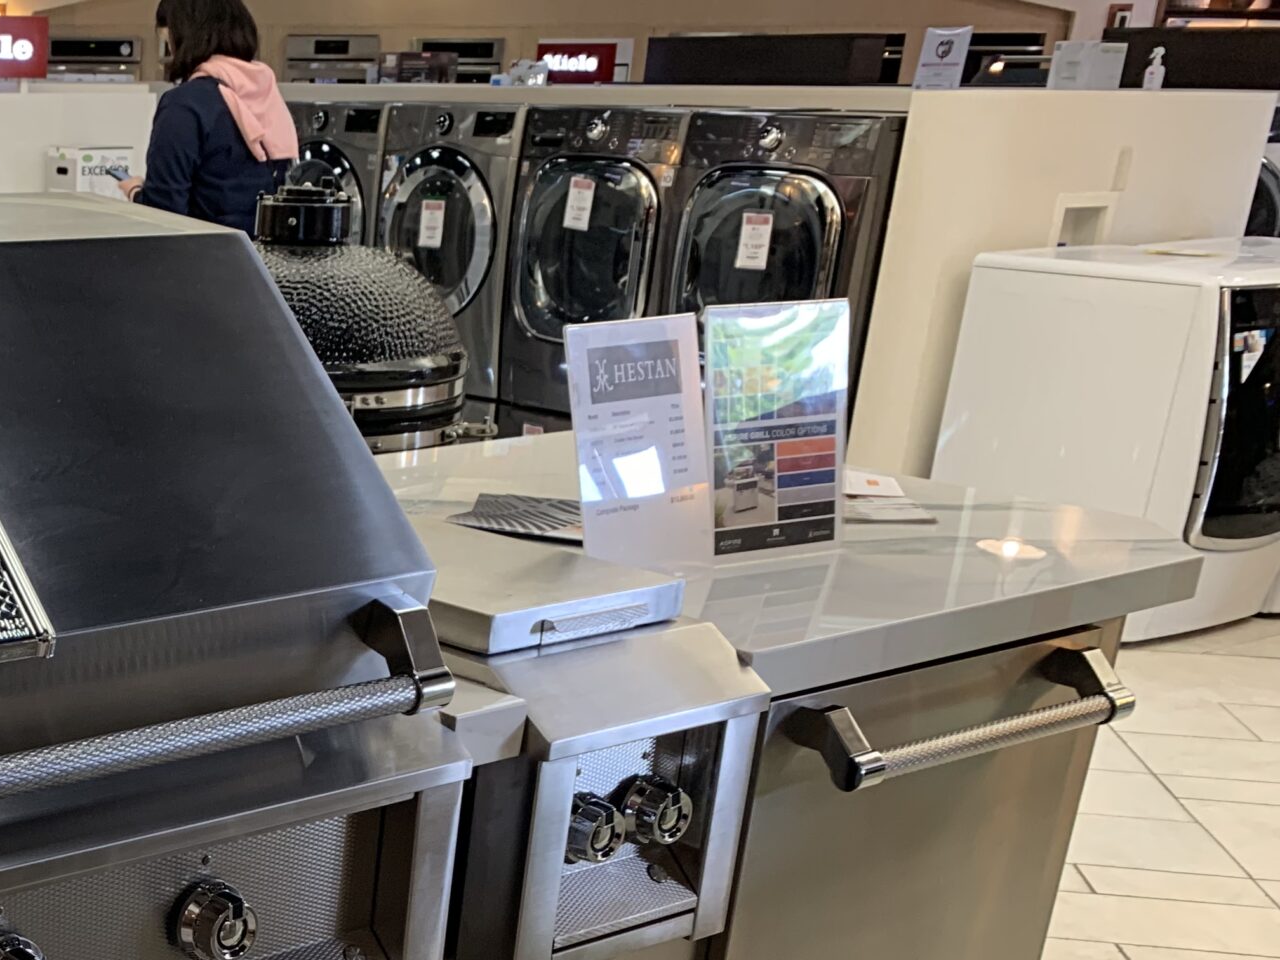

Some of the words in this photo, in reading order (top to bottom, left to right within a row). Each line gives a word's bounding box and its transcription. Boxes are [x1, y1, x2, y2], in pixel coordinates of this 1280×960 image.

[614, 358, 677, 384] HESTAN
[772, 427, 796, 438] COLOR
[797, 423, 828, 436] OPTIONS
